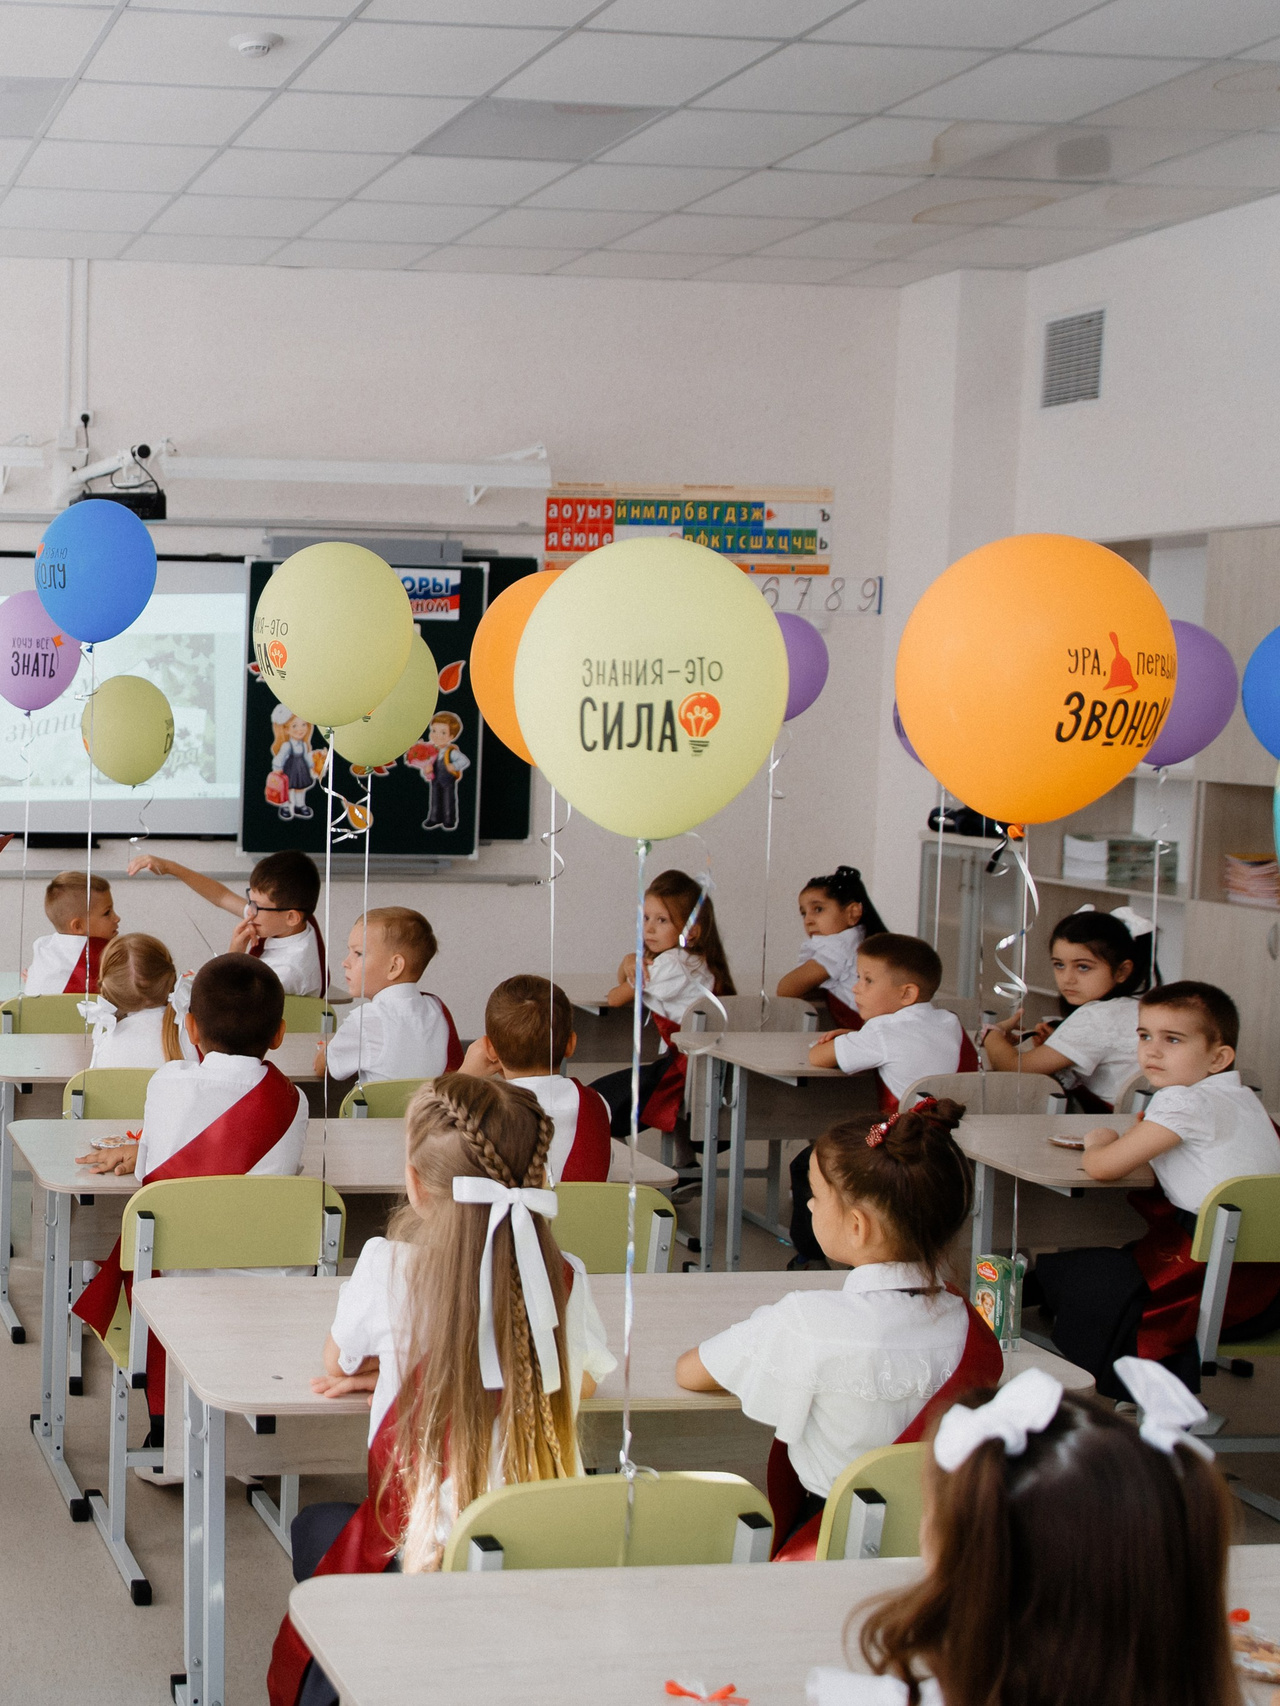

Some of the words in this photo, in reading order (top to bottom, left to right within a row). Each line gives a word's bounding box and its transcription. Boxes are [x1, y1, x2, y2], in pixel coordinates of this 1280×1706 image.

[410, 600, 449, 613] НОМ
[794, 576, 813, 610] 7
[825, 577, 846, 611] 8
[858, 578, 877, 612] 9
[12, 637, 33, 649] ХОЧУ
[11, 651, 56, 679] ЗНАТЬ
[1067, 647, 1107, 677] УРА,
[580, 696, 678, 753] СИЛА
[1055, 690, 1171, 748] ЗВОНОК
